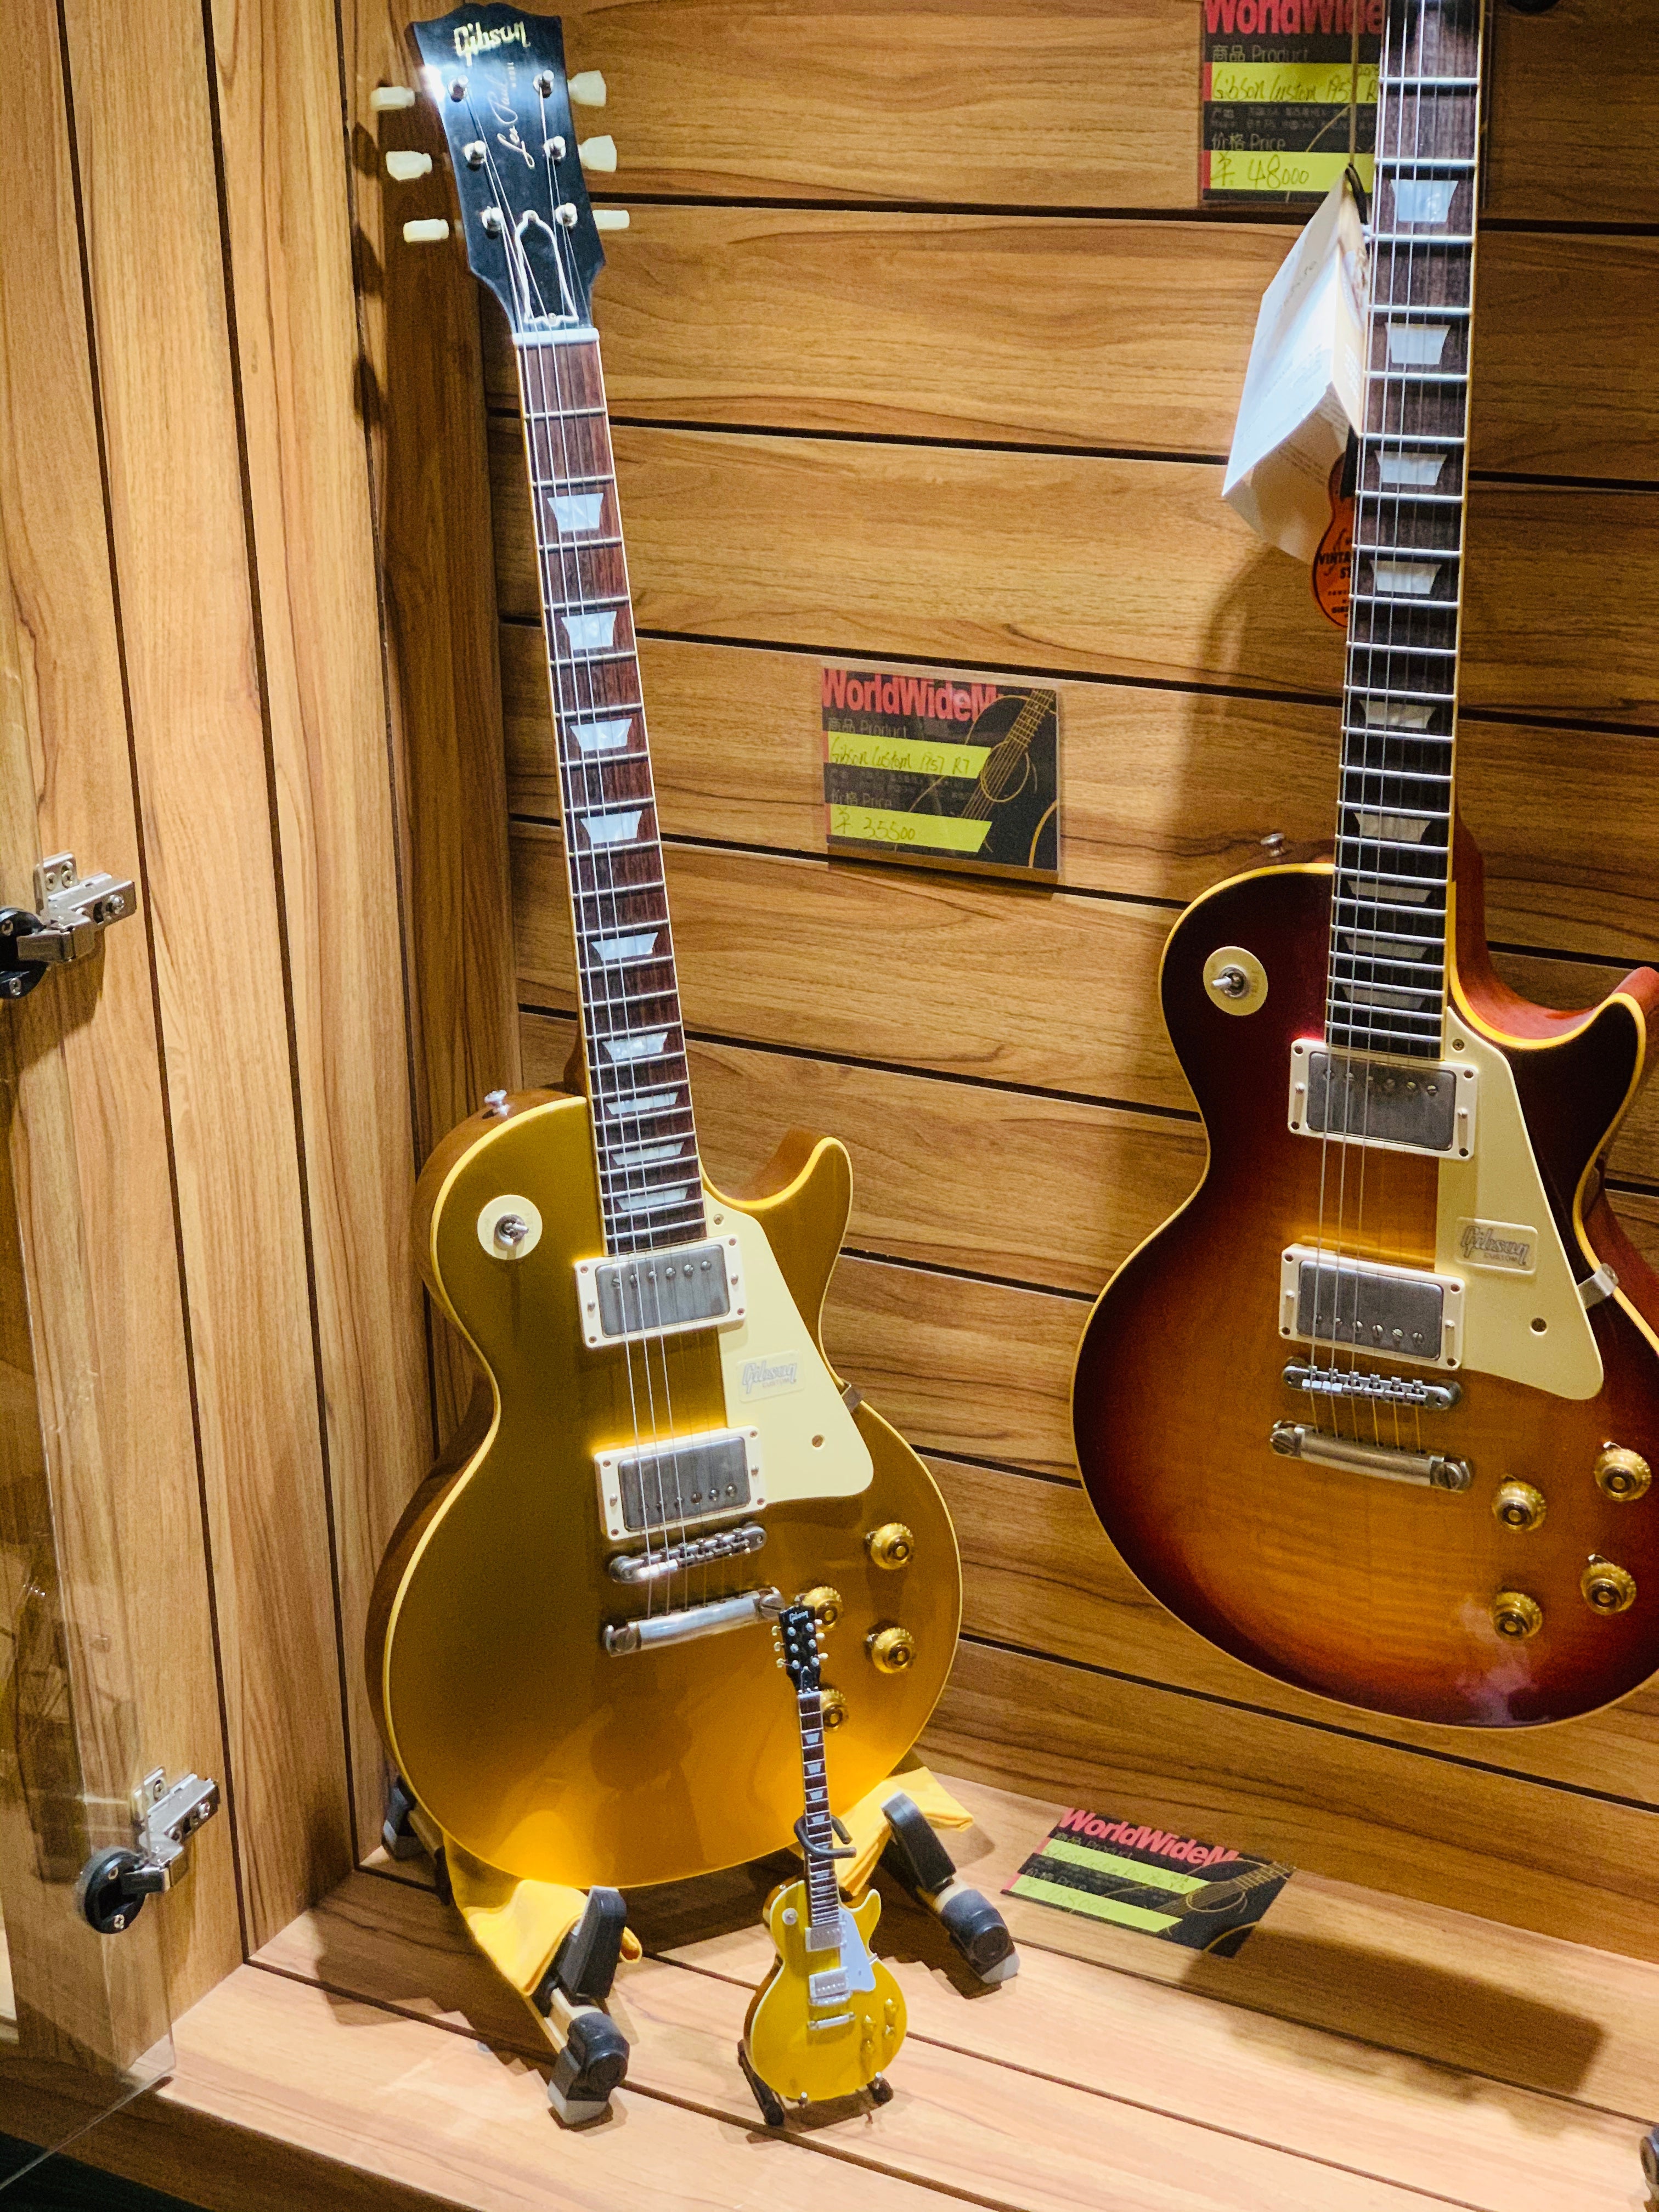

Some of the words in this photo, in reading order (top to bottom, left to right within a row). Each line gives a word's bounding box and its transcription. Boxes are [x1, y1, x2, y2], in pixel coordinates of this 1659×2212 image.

[454, 21, 530, 66] Gibson
[1212, 44, 1245, 63] 商品
[1251, 44, 1308, 63] Product
[1211, 133, 1245, 151] 价格
[1250, 133, 1286, 151] Price
[1247, 154, 1310, 189] 48000
[863, 817, 916, 841] 35500
[1460, 1226, 1530, 1266] Gibson
[742, 1360, 798, 1394] Gibson
